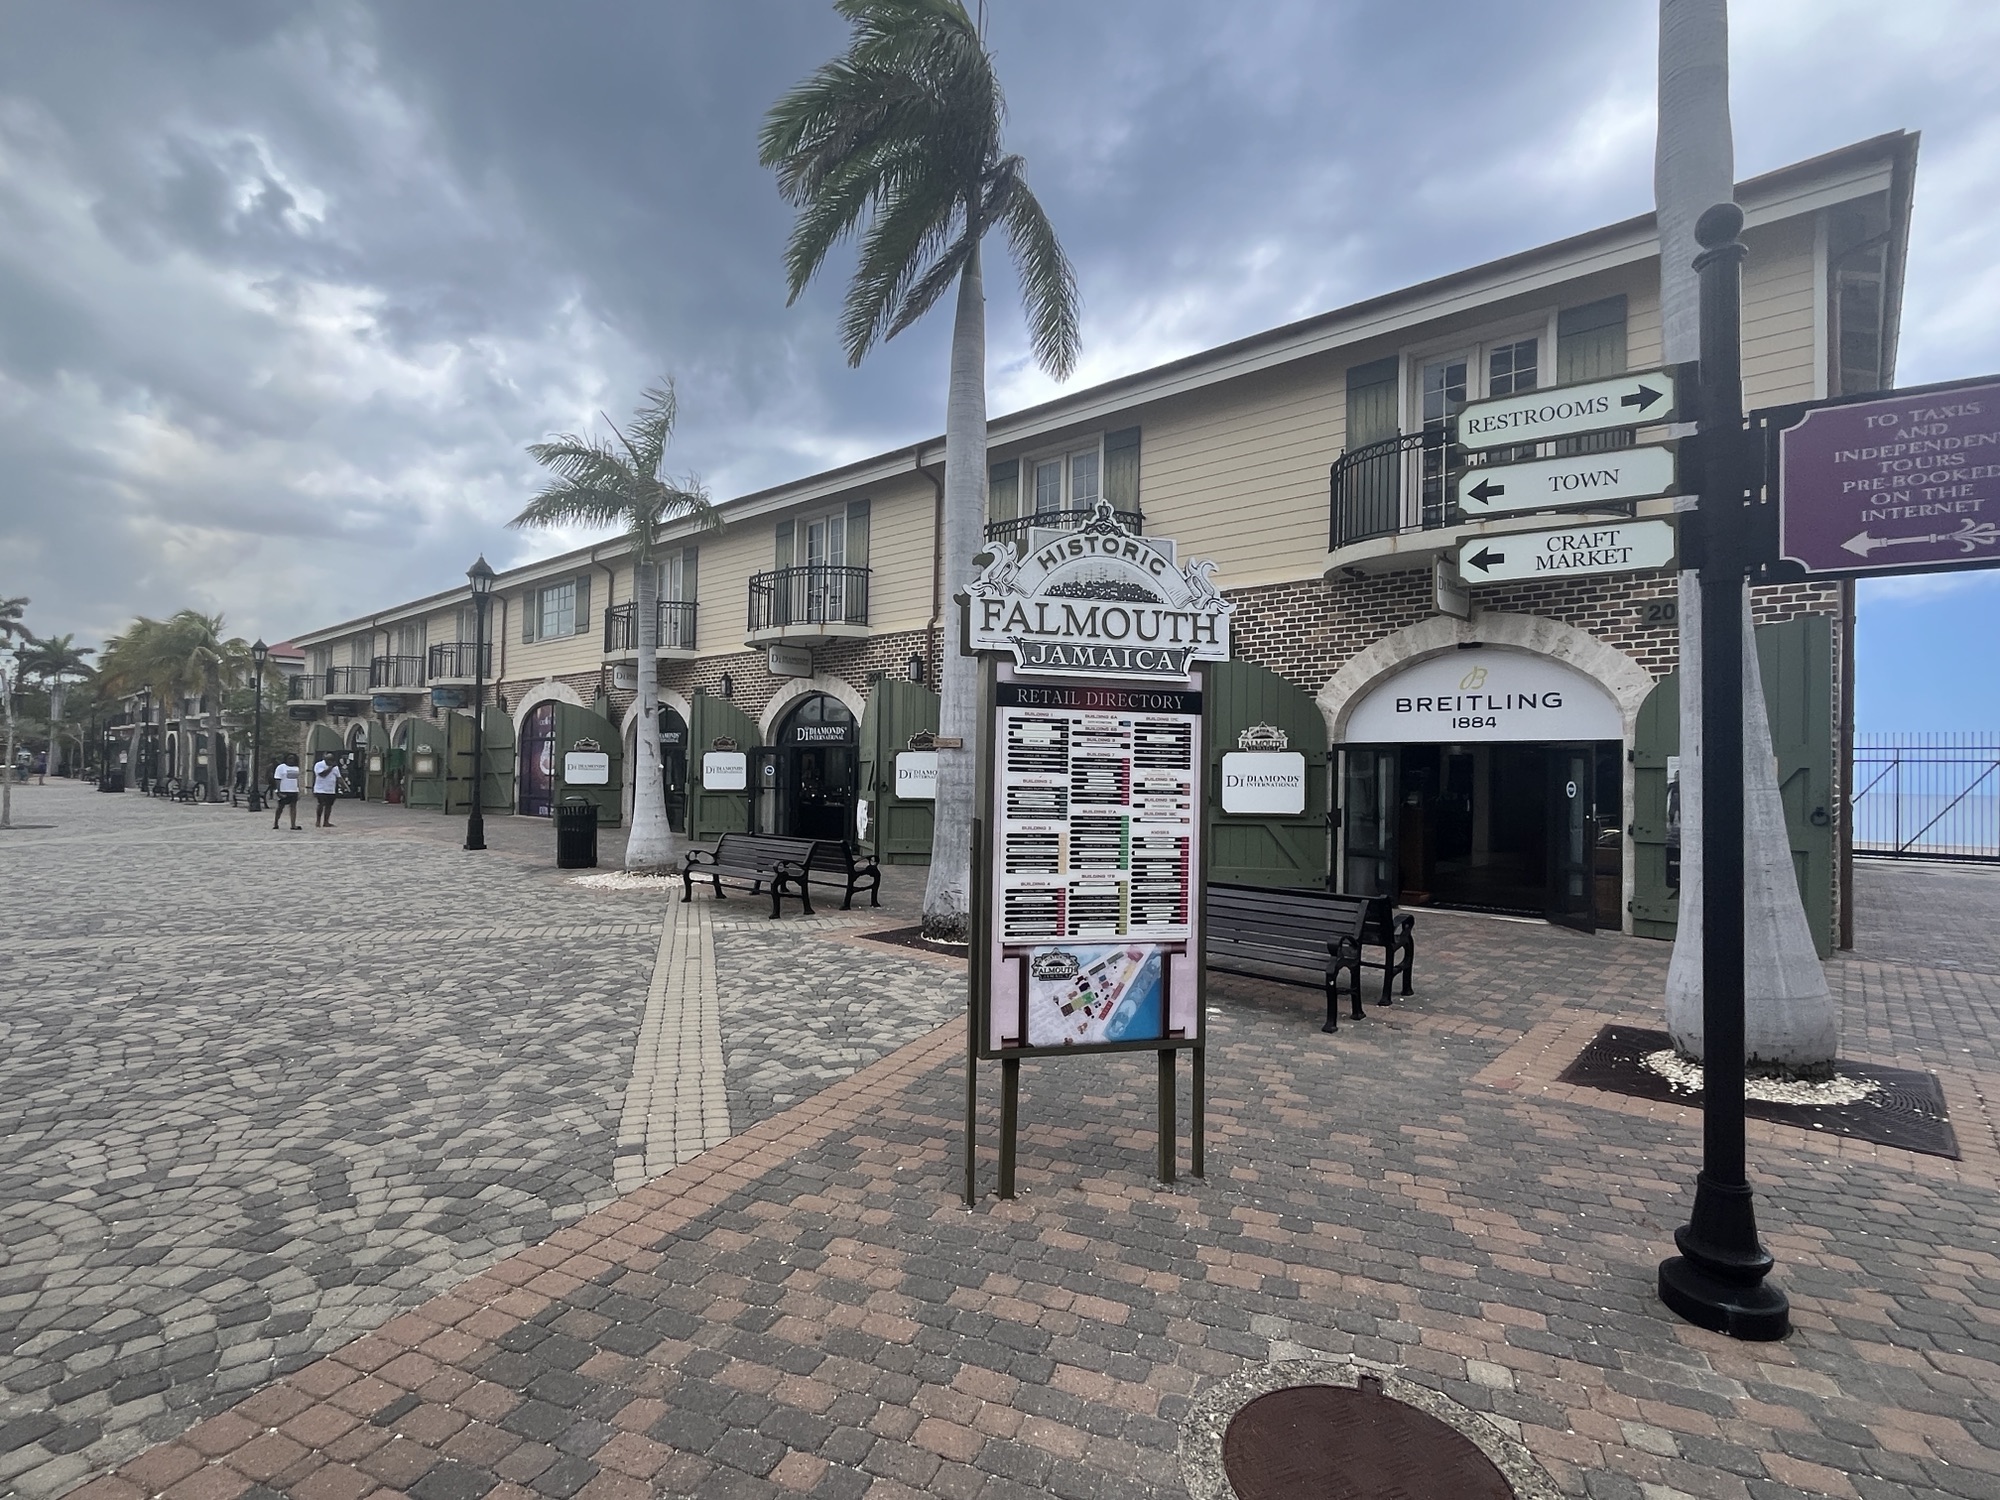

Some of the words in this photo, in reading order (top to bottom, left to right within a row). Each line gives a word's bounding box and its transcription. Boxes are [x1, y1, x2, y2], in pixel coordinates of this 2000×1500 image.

[1468, 397, 1609, 434] RESTROOMS
[1864, 413, 1899, 428] TO
[1908, 402, 1981, 422] TAXIS
[1895, 423, 1948, 440] AND
[1834, 432, 2000, 463] INDEPENDEN
[1878, 452, 1965, 473] TOURS
[1549, 469, 1620, 492] TOWN
[1871, 490, 1910, 505] ON
[1922, 484, 1974, 500] THE
[1862, 499, 1985, 522] INTERNET
[1546, 530, 1620, 552] CRAFT
[1037, 536, 1166, 576] HISTORIC
[1535, 547, 1633, 571] MARKET
[980, 599, 1219, 644] FALMOUTH
[1649, 604, 1678, 621] 20
[1031, 644, 1176, 671] JAMAICA
[1017, 688, 1080, 705] RETAIL
[1086, 692, 1184, 709] DIRECTORY
[1396, 692, 1562, 713] BREITLING
[1452, 716, 1497, 729] 1884
